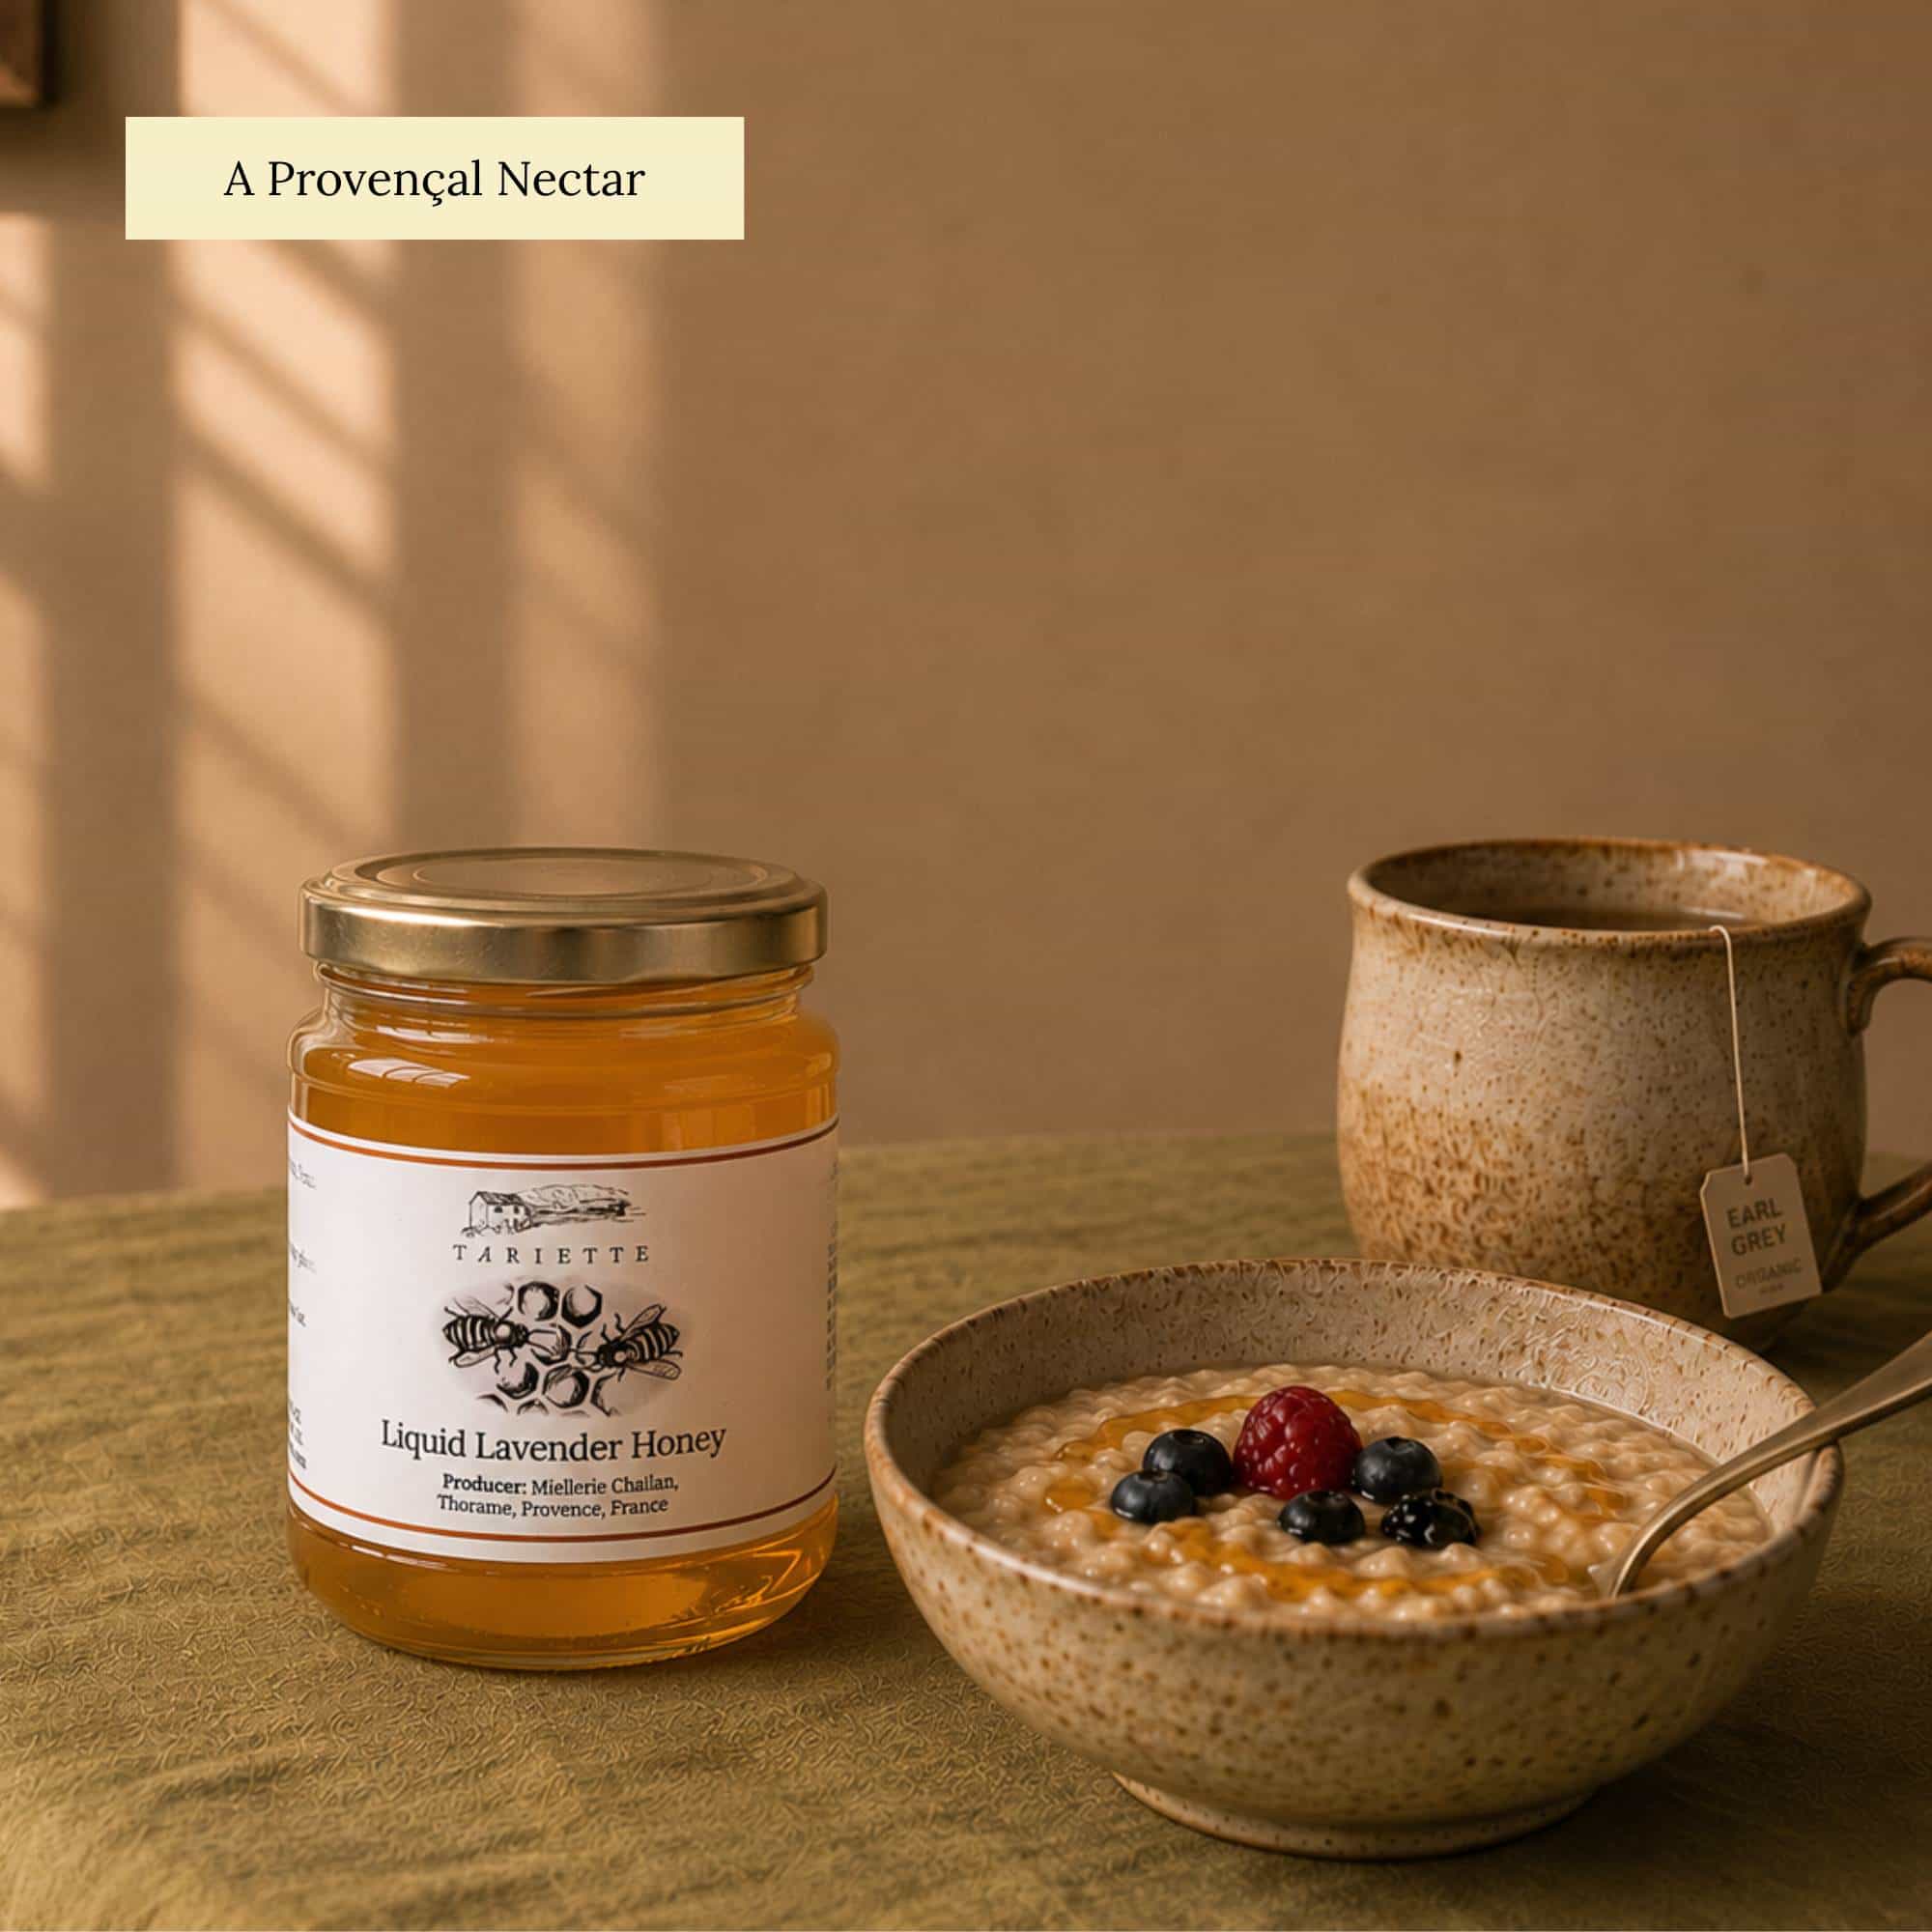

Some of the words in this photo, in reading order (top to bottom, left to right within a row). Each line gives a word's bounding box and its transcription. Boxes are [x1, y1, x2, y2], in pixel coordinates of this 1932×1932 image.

[1726, 1198, 1783, 1228] EARL
[1731, 1223, 1785, 1256] GREY
[452, 1244, 649, 1265] TARIETTE
[381, 1419, 467, 1461] Liquid
[475, 1432, 623, 1463] Lavender
[631, 1428, 727, 1459] Honey
[442, 1473, 526, 1495] Producer:
[531, 1478, 607, 1496] Miellerie
[437, 1493, 517, 1520] Thorame,
[522, 1500, 606, 1520] Provence,
[611, 1498, 669, 1517] France
